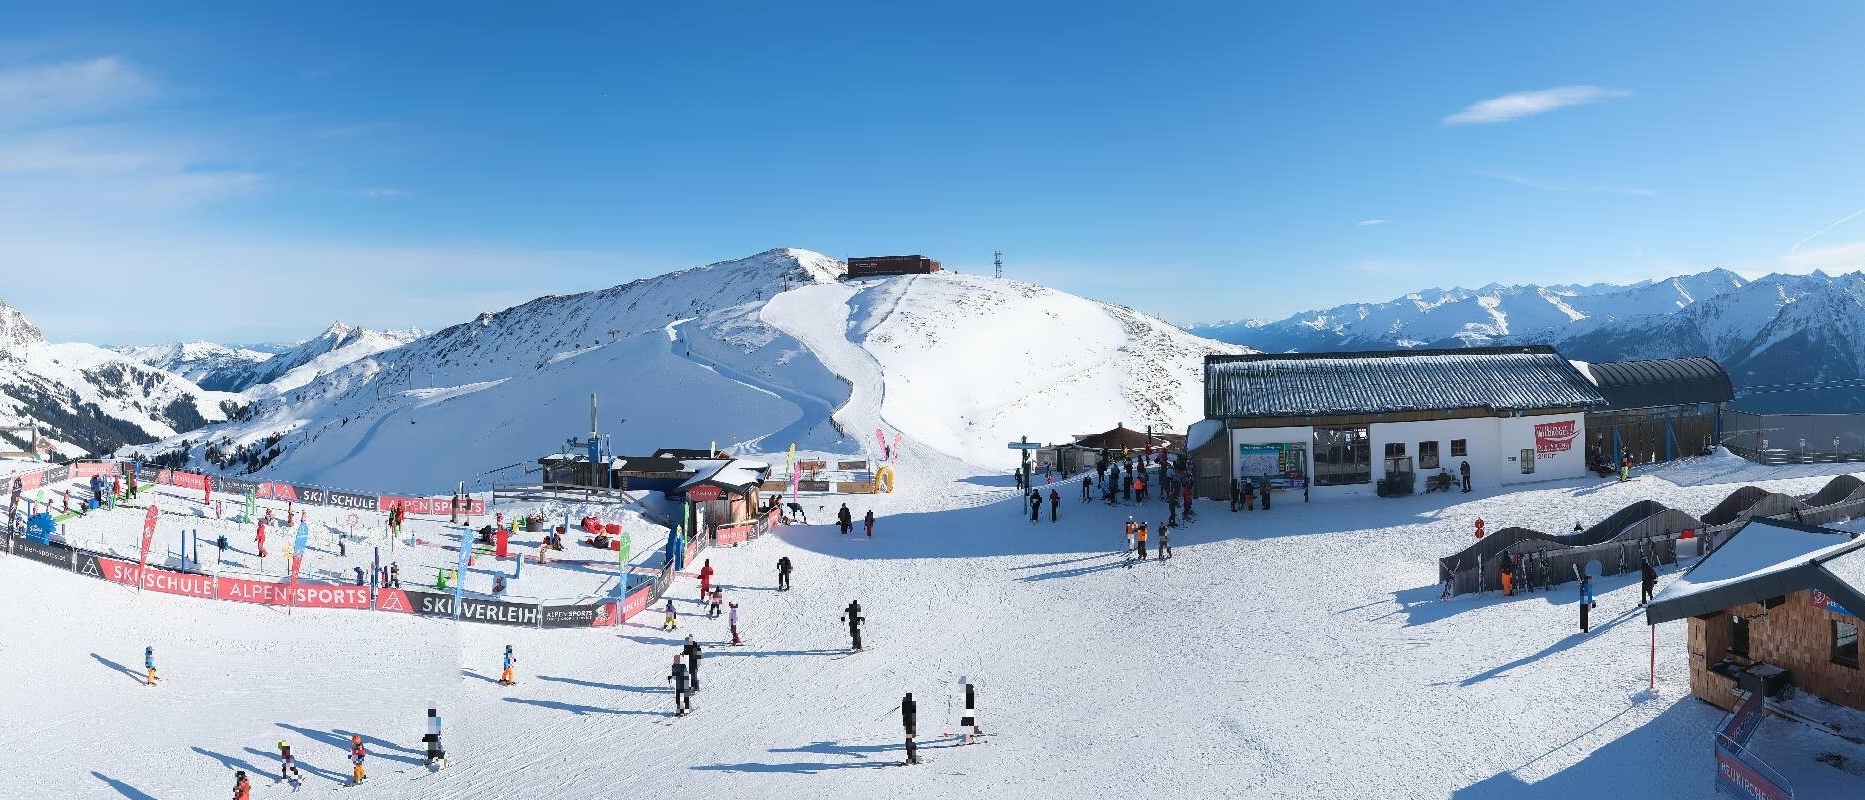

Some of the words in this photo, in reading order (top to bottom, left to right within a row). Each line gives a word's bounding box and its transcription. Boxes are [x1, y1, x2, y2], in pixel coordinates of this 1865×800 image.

[303, 490, 323, 502] SKI
[330, 493, 376, 510] SCHULE
[388, 500, 429, 512] APEN
[434, 501, 482, 513] SPRTS
[114, 565, 138, 584] SKI
[145, 572, 213, 595] SCHULE
[230, 580, 287, 601] ALPEN
[296, 587, 367, 605] SPORTS
[422, 596, 457, 614] SKI
[462, 600, 537, 625] VERLEIH
[1721, 762, 1774, 800] NEUKIRCHE
